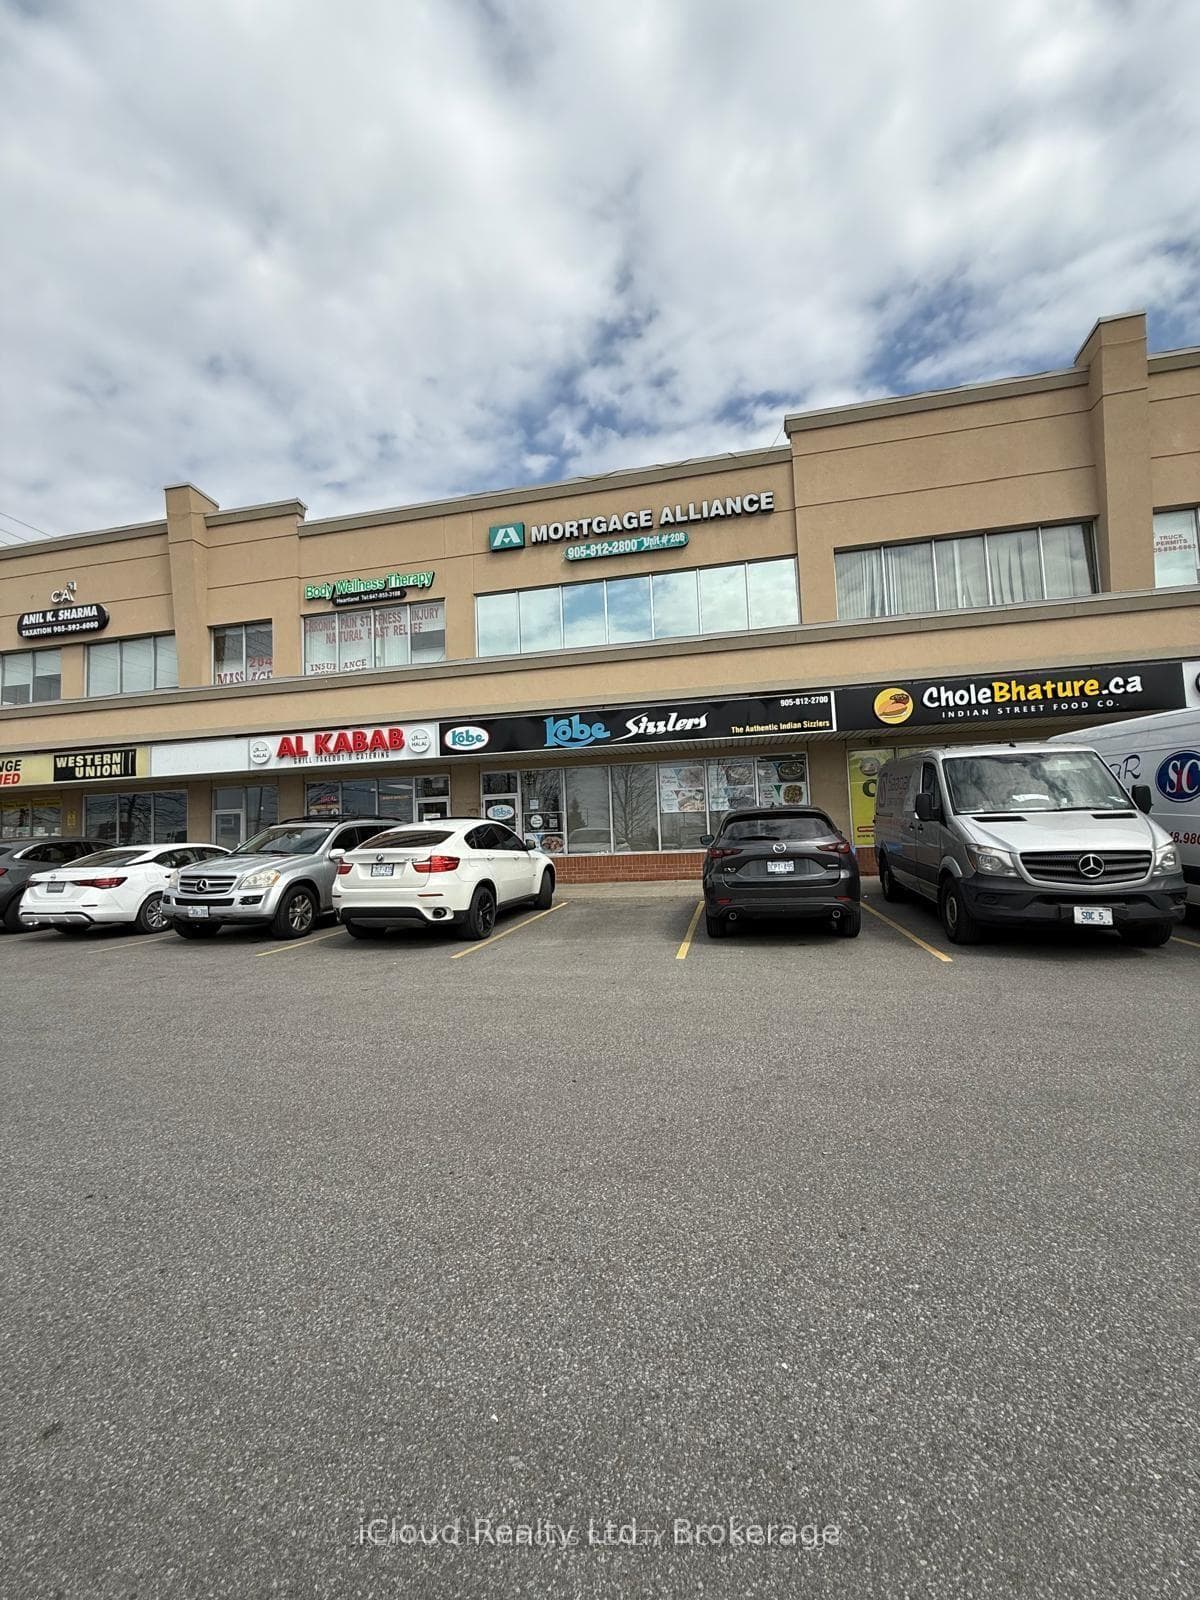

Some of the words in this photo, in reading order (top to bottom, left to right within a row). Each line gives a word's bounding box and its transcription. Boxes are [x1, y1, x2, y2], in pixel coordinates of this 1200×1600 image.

[530, 510, 653, 543] MORTGAGE
[659, 491, 774, 525] ALLIANCE
[567, 539, 638, 559] 905-812-2800
[305, 583, 333, 599] Body
[335, 579, 386, 594] Wellness
[387, 572, 433, 588] Therapy
[22, 613, 44, 625] ANIL
[46, 611, 56, 622] K.
[58, 605, 98, 620] SHARMA
[411, 607, 439, 621] INJURY
[22, 626, 52, 636] TAXATION
[249, 656, 273, 668] 204
[922, 675, 1143, 708] CholeBhature.ca
[942, 709, 990, 718] INDIAN
[997, 704, 1046, 715] STREET
[1053, 701, 1090, 711] FOOD
[1097, 699, 1121, 708] CO.
[543, 714, 611, 748] Kobe
[611, 711, 709, 742] Sizzlers
[731, 726, 744, 734] The
[745, 723, 779, 733] Authentic
[780, 721, 802, 730] Indian
[803, 719, 830, 729] Sizzlers
[276, 736, 309, 758] AL
[315, 728, 405, 756] KABAB
[451, 730, 485, 747] Kobe
[56, 752, 121, 768] WESTERN
[356, 751, 391, 761] CATERING
[75, 764, 121, 778] UNION
